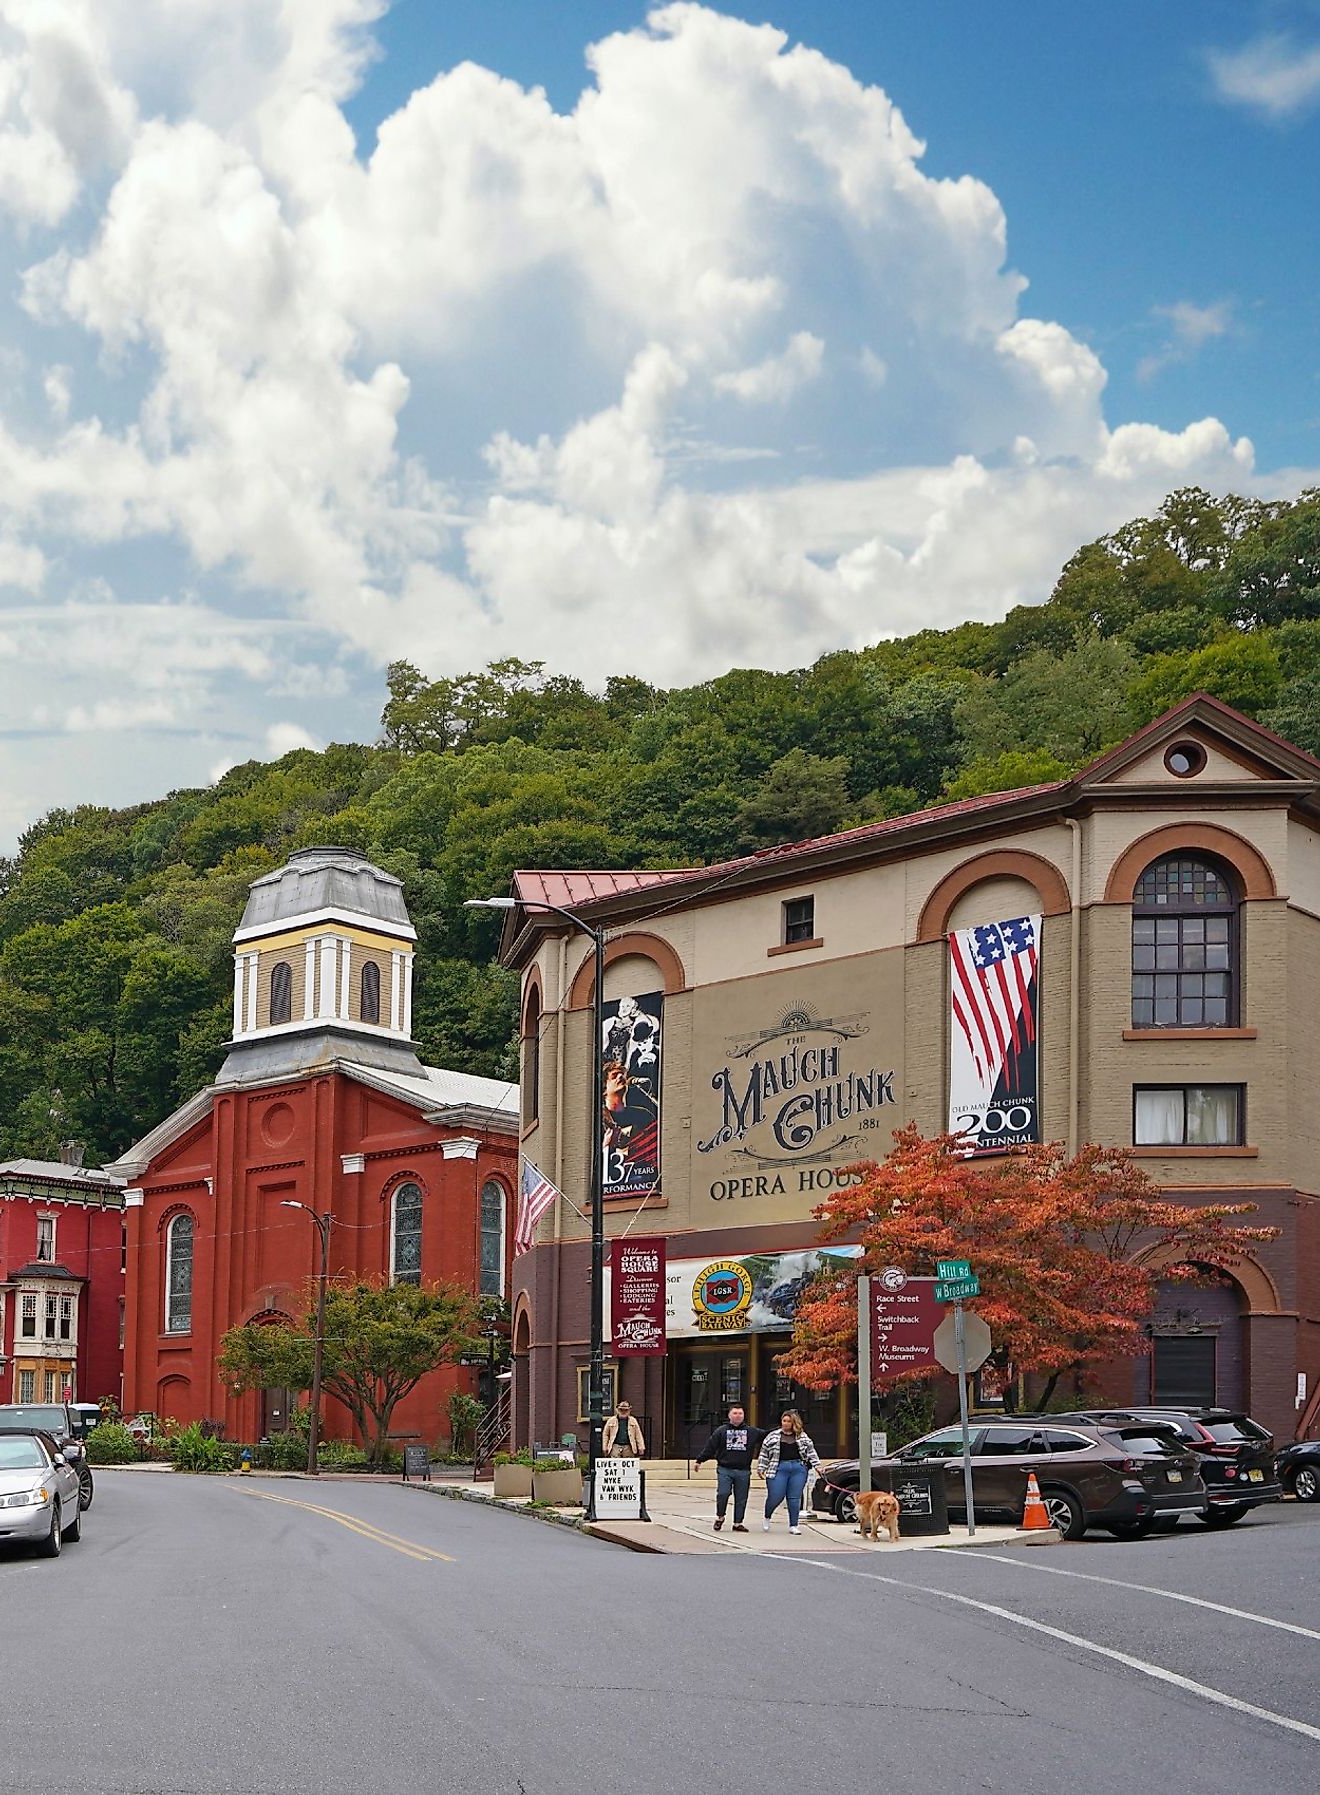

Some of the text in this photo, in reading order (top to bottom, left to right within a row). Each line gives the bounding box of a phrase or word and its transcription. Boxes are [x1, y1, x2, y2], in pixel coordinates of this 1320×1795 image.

[786, 1035, 806, 1046] THE
[697, 1045, 840, 1152] MAUCH
[970, 1100, 1001, 1111] MAUCH
[1002, 1096, 1035, 1107] CHUNK
[772, 1068, 897, 1151] CHUNK
[858, 1118, 880, 1131] 1881
[956, 1106, 1031, 1138] 200
[633, 1166, 655, 1175] YEARS
[710, 1166, 865, 1201] OPERA HOUS
[940, 1264, 969, 1278] Hill Rd
[727, 1263, 751, 1297] GORGE
[943, 1283, 978, 1298] Broadway
[876, 1295, 920, 1303] Race Street
[701, 1314, 744, 1324] SCENIC
[701, 1321, 744, 1330] RAILWAY
[877, 1316, 920, 1324] Switchback
[613, 1321, 651, 1339] MAUCH
[877, 1323, 893, 1331] Trail
[891, 1344, 930, 1355] Broadway
[878, 1352, 916, 1361] Museums
